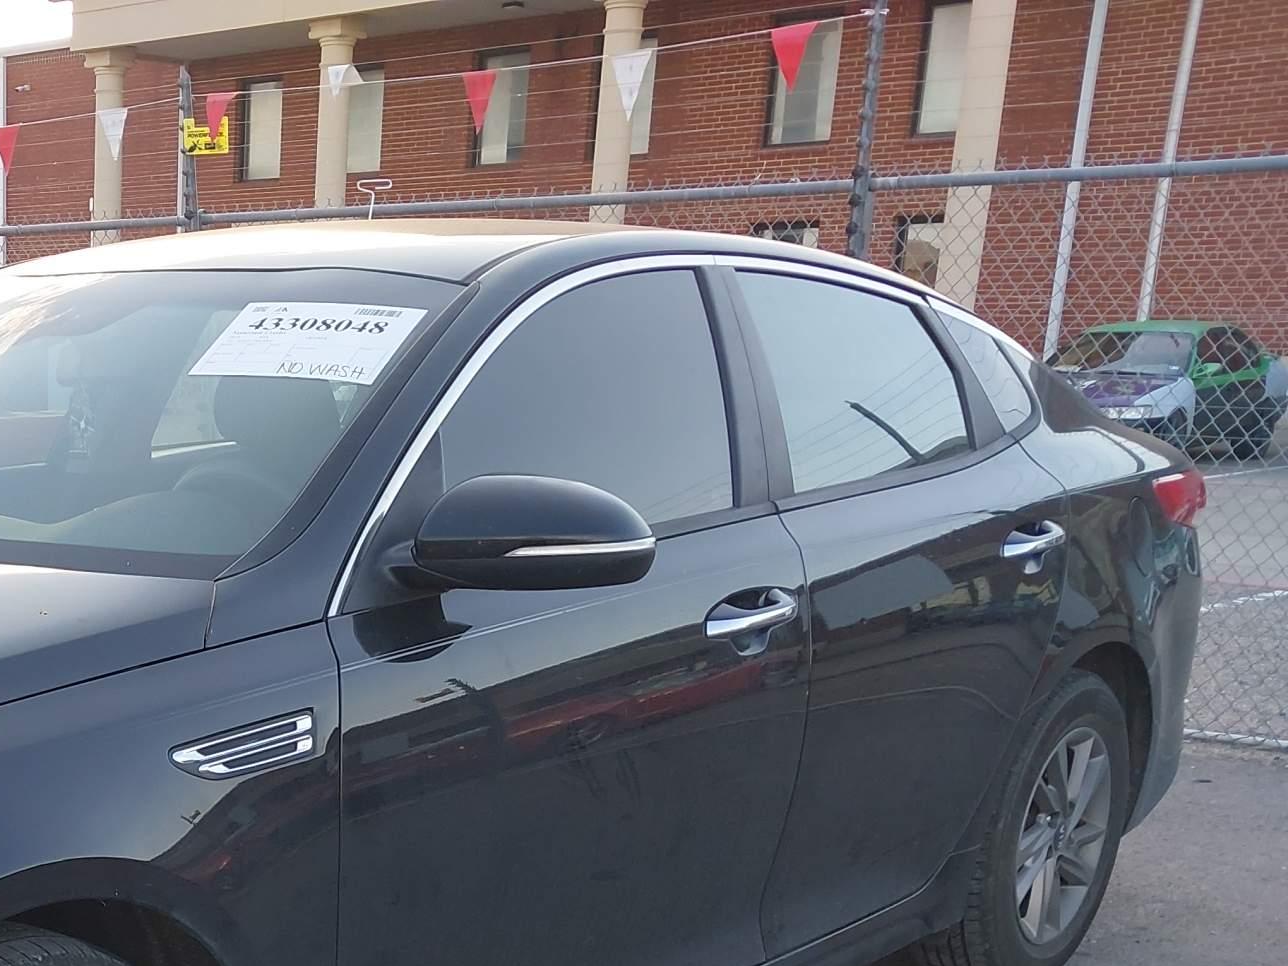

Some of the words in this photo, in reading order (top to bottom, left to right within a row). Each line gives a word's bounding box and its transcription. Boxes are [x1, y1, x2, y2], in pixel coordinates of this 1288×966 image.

[248, 317, 389, 334] 43308048
[276, 362, 304, 374] NO
[309, 363, 367, 380] WASH
